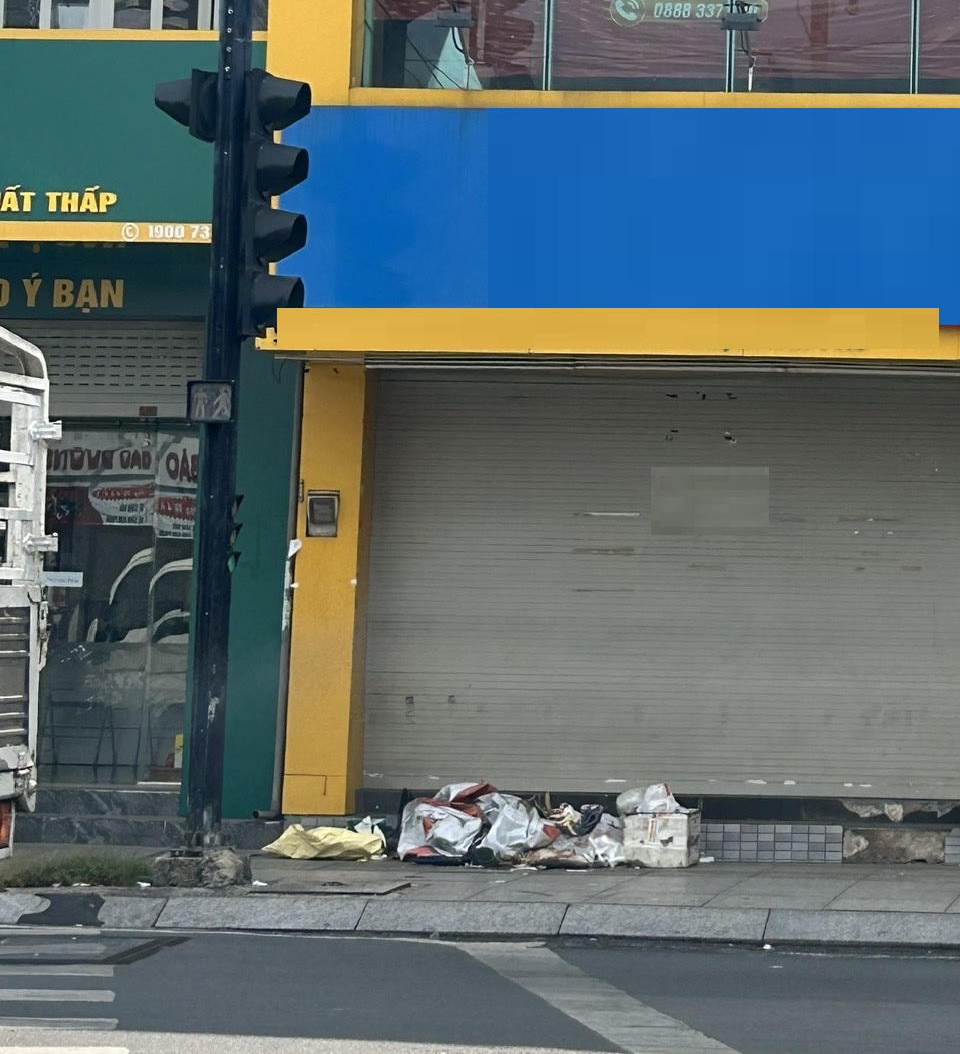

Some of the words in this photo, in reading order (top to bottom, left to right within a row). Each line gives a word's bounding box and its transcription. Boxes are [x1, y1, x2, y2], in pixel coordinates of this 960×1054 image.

[653, 2, 692, 18] 0888
[695, 3, 724, 18] 337
[0, 184, 36, 212] ẤT
[45, 185, 118, 213] THẤP
[148, 225, 185, 239] 1900
[22, 272, 43, 307] Ý
[53, 279, 124, 313] BẠN
